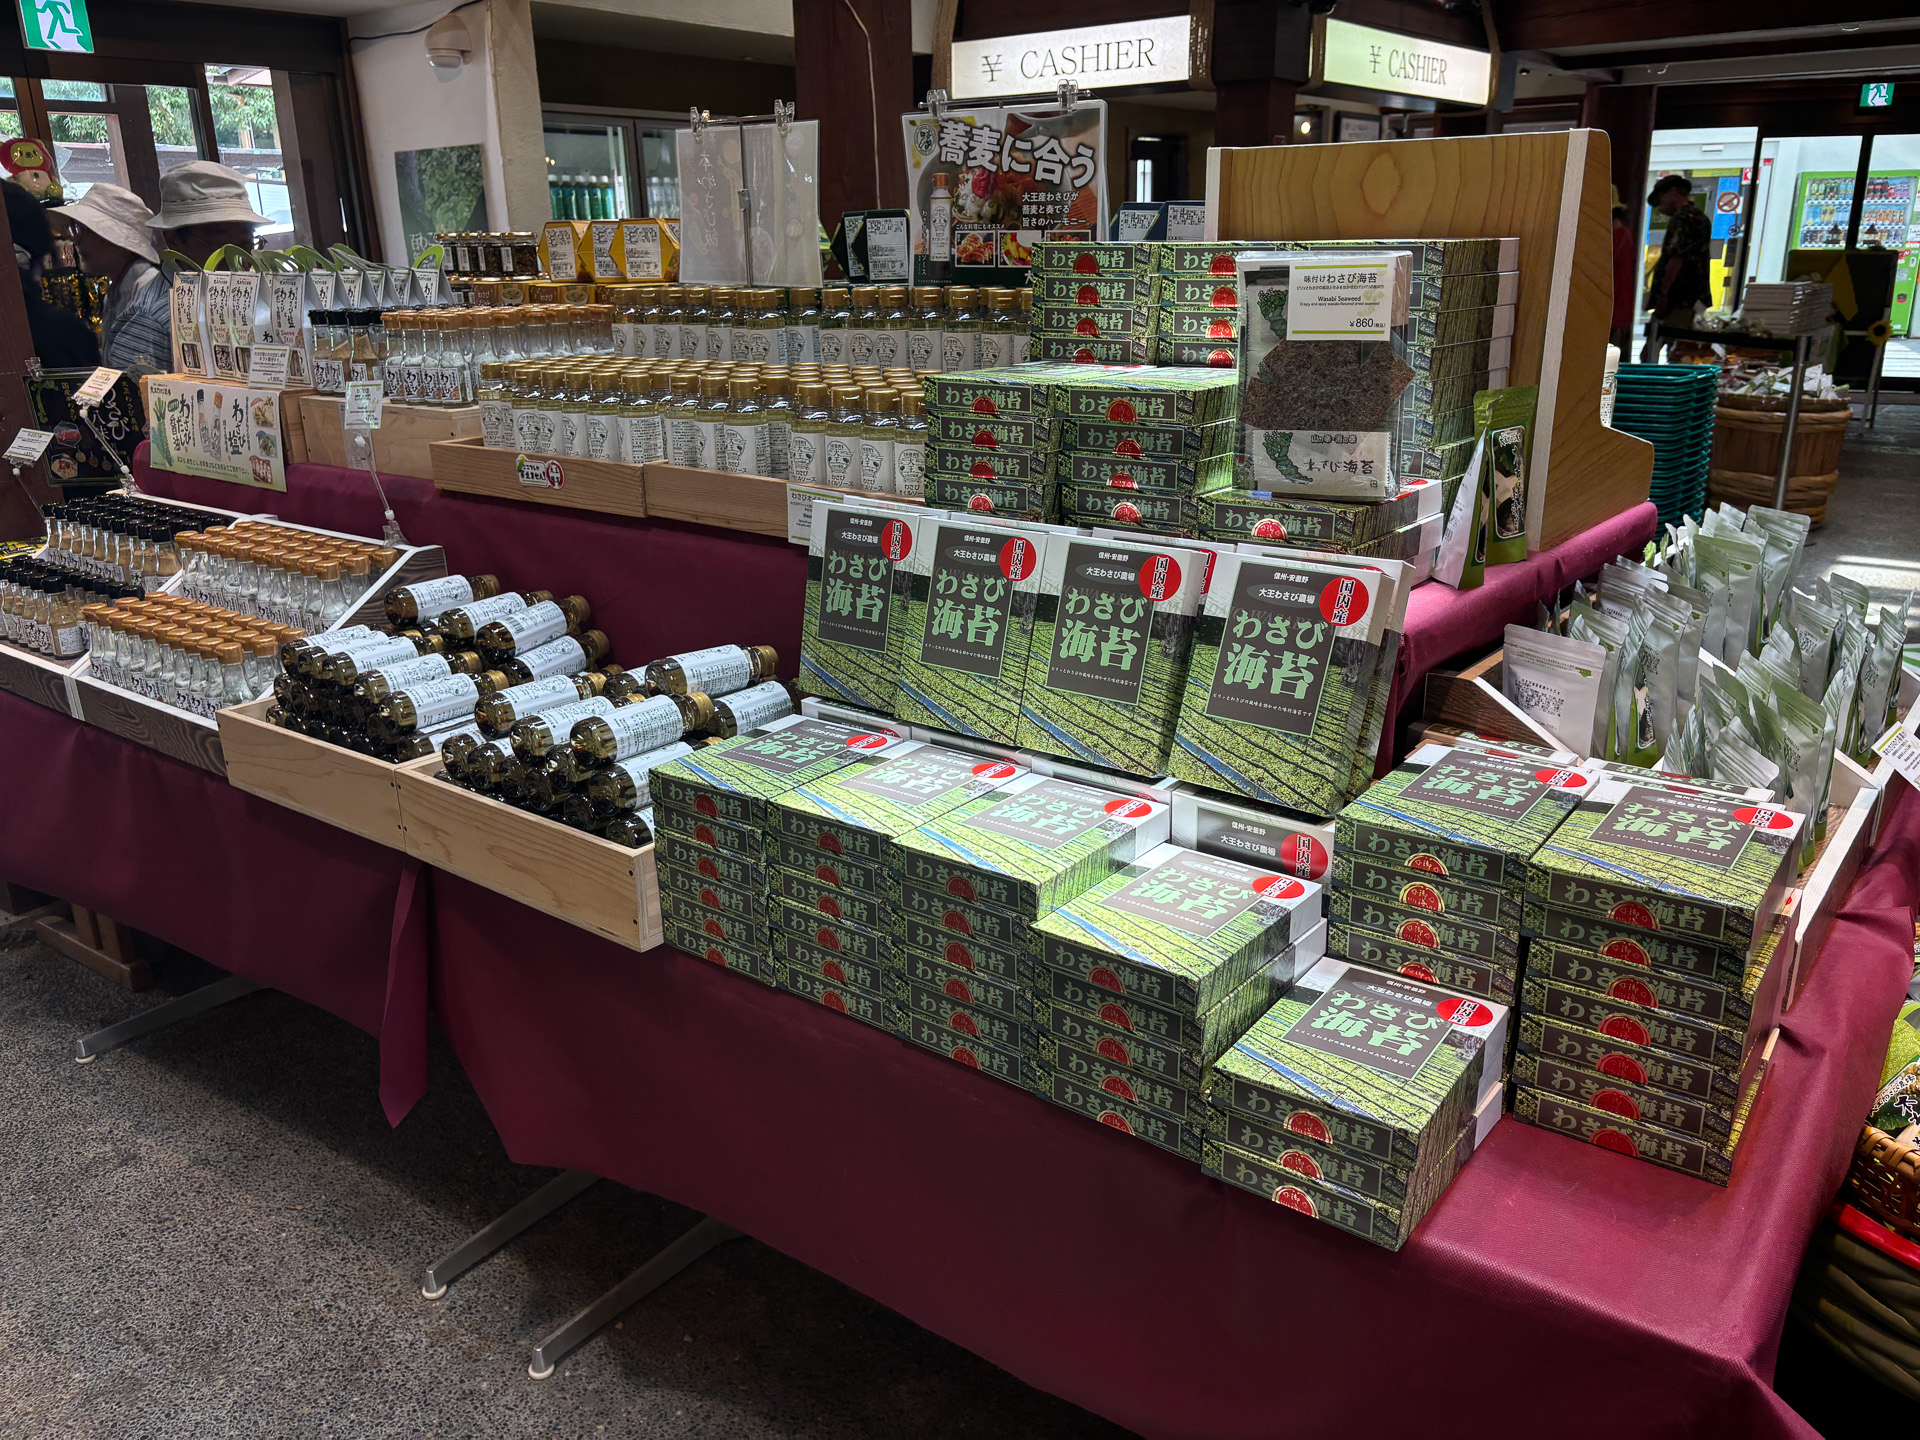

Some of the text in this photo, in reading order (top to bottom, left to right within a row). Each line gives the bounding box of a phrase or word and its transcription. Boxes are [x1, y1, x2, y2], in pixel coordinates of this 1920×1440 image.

[981, 37, 1157, 82] ¥ CASHIER
[1369, 45, 1448, 85] ¥ CASHIER
[938, 119, 1096, 188] 蕎麦に合う
[1022, 191, 1080, 202] 大王産わさびが
[1022, 204, 1070, 215] 蕎麦と奏でる
[1022, 217, 1090, 228] 旨さのハーモニー。
[1052, 250, 1125, 268] わさ海苔
[1303, 272, 1378, 284] 味付けわさび海苔
[1053, 281, 1126, 300] わさ海苔
[1349, 318, 1374, 328] ¥860
[1079, 394, 1166, 418] わさ海苔
[946, 452, 1021, 477] わさ海苔
[1086, 493, 1171, 521] わさ海苔
[1225, 509, 1323, 537] わさ海苔
[889, 521, 902, 559] 国内産
[953, 549, 997, 563] 大王わさび農場
[1009, 539, 1025, 579] 国内産
[828, 550, 889, 581] わさび
[936, 568, 1007, 603] わさび
[1086, 566, 1136, 582] 大王わさび農場
[1150, 557, 1170, 600] 国内産
[825, 577, 886, 623] 海苔
[1065, 587, 1148, 624] わさび
[1258, 587, 1316, 605] 大王わさび農場
[1331, 577, 1355, 624] 国内産
[931, 598, 1002, 647] 海苔
[1232, 610, 1329, 650] わさび
[1059, 618, 1141, 671] 海苔
[1223, 642, 1319, 700] 海苔
[743, 738, 826, 764] 海苔
[773, 731, 847, 751] わさび
[864, 766, 953, 794] 海苔
[893, 757, 973, 780] わさび
[1437, 764, 1545, 790] わさび
[669, 782, 742, 818] わさ海苔
[1016, 792, 1108, 819] わさび
[1421, 774, 1532, 806] 海苔
[671, 811, 740, 849] わさ海苔
[989, 802, 1087, 835] 海苔
[1231, 821, 1267, 836] 信州・安曇野
[1612, 813, 1737, 851] 海苔
[1623, 802, 1746, 831] わさび
[673, 843, 743, 882] わさ海苔
[1220, 834, 1276, 857] 大王わさび農場
[1294, 834, 1311, 879] 国内産
[788, 846, 865, 888] わさ海苔
[1155, 867, 1258, 900] わさび
[676, 872, 744, 912] わさ海苔
[791, 879, 868, 922] わさ海苔
[1129, 879, 1237, 920] 海苔
[1365, 868, 1484, 915] わさ海苔
[1565, 881, 1709, 932] わさ海苔
[790, 911, 868, 956] わさ海苔
[911, 891, 1000, 937] わさ海苔
[1362, 904, 1480, 952] わさ海苔
[683, 931, 750, 972] わさ海苔
[916, 926, 1006, 975] わさ海苔
[1560, 917, 1702, 970] わさ海苔
[797, 974, 873, 1019] わさ海苔
[915, 960, 1004, 1008] わさ海苔
[1567, 959, 1709, 1013] わさ海苔
[920, 992, 1009, 1042] わさ海苔
[1330, 991, 1445, 1030] わさび
[1447, 999, 1479, 1025] 国内産
[1560, 996, 1699, 1051] わさ海苔
[1062, 1015, 1166, 1073] わさ海苔
[1310, 1005, 1430, 1057] 海苔
[1557, 1034, 1696, 1091] わさ海苔
[1551, 1070, 1689, 1128] わさ海苔
[1247, 1090, 1376, 1150] わさ海苔
[1552, 1107, 1690, 1166] わさ海苔
[1241, 1124, 1365, 1188] わさ海苔
[1236, 1161, 1357, 1227] わさ海苔
